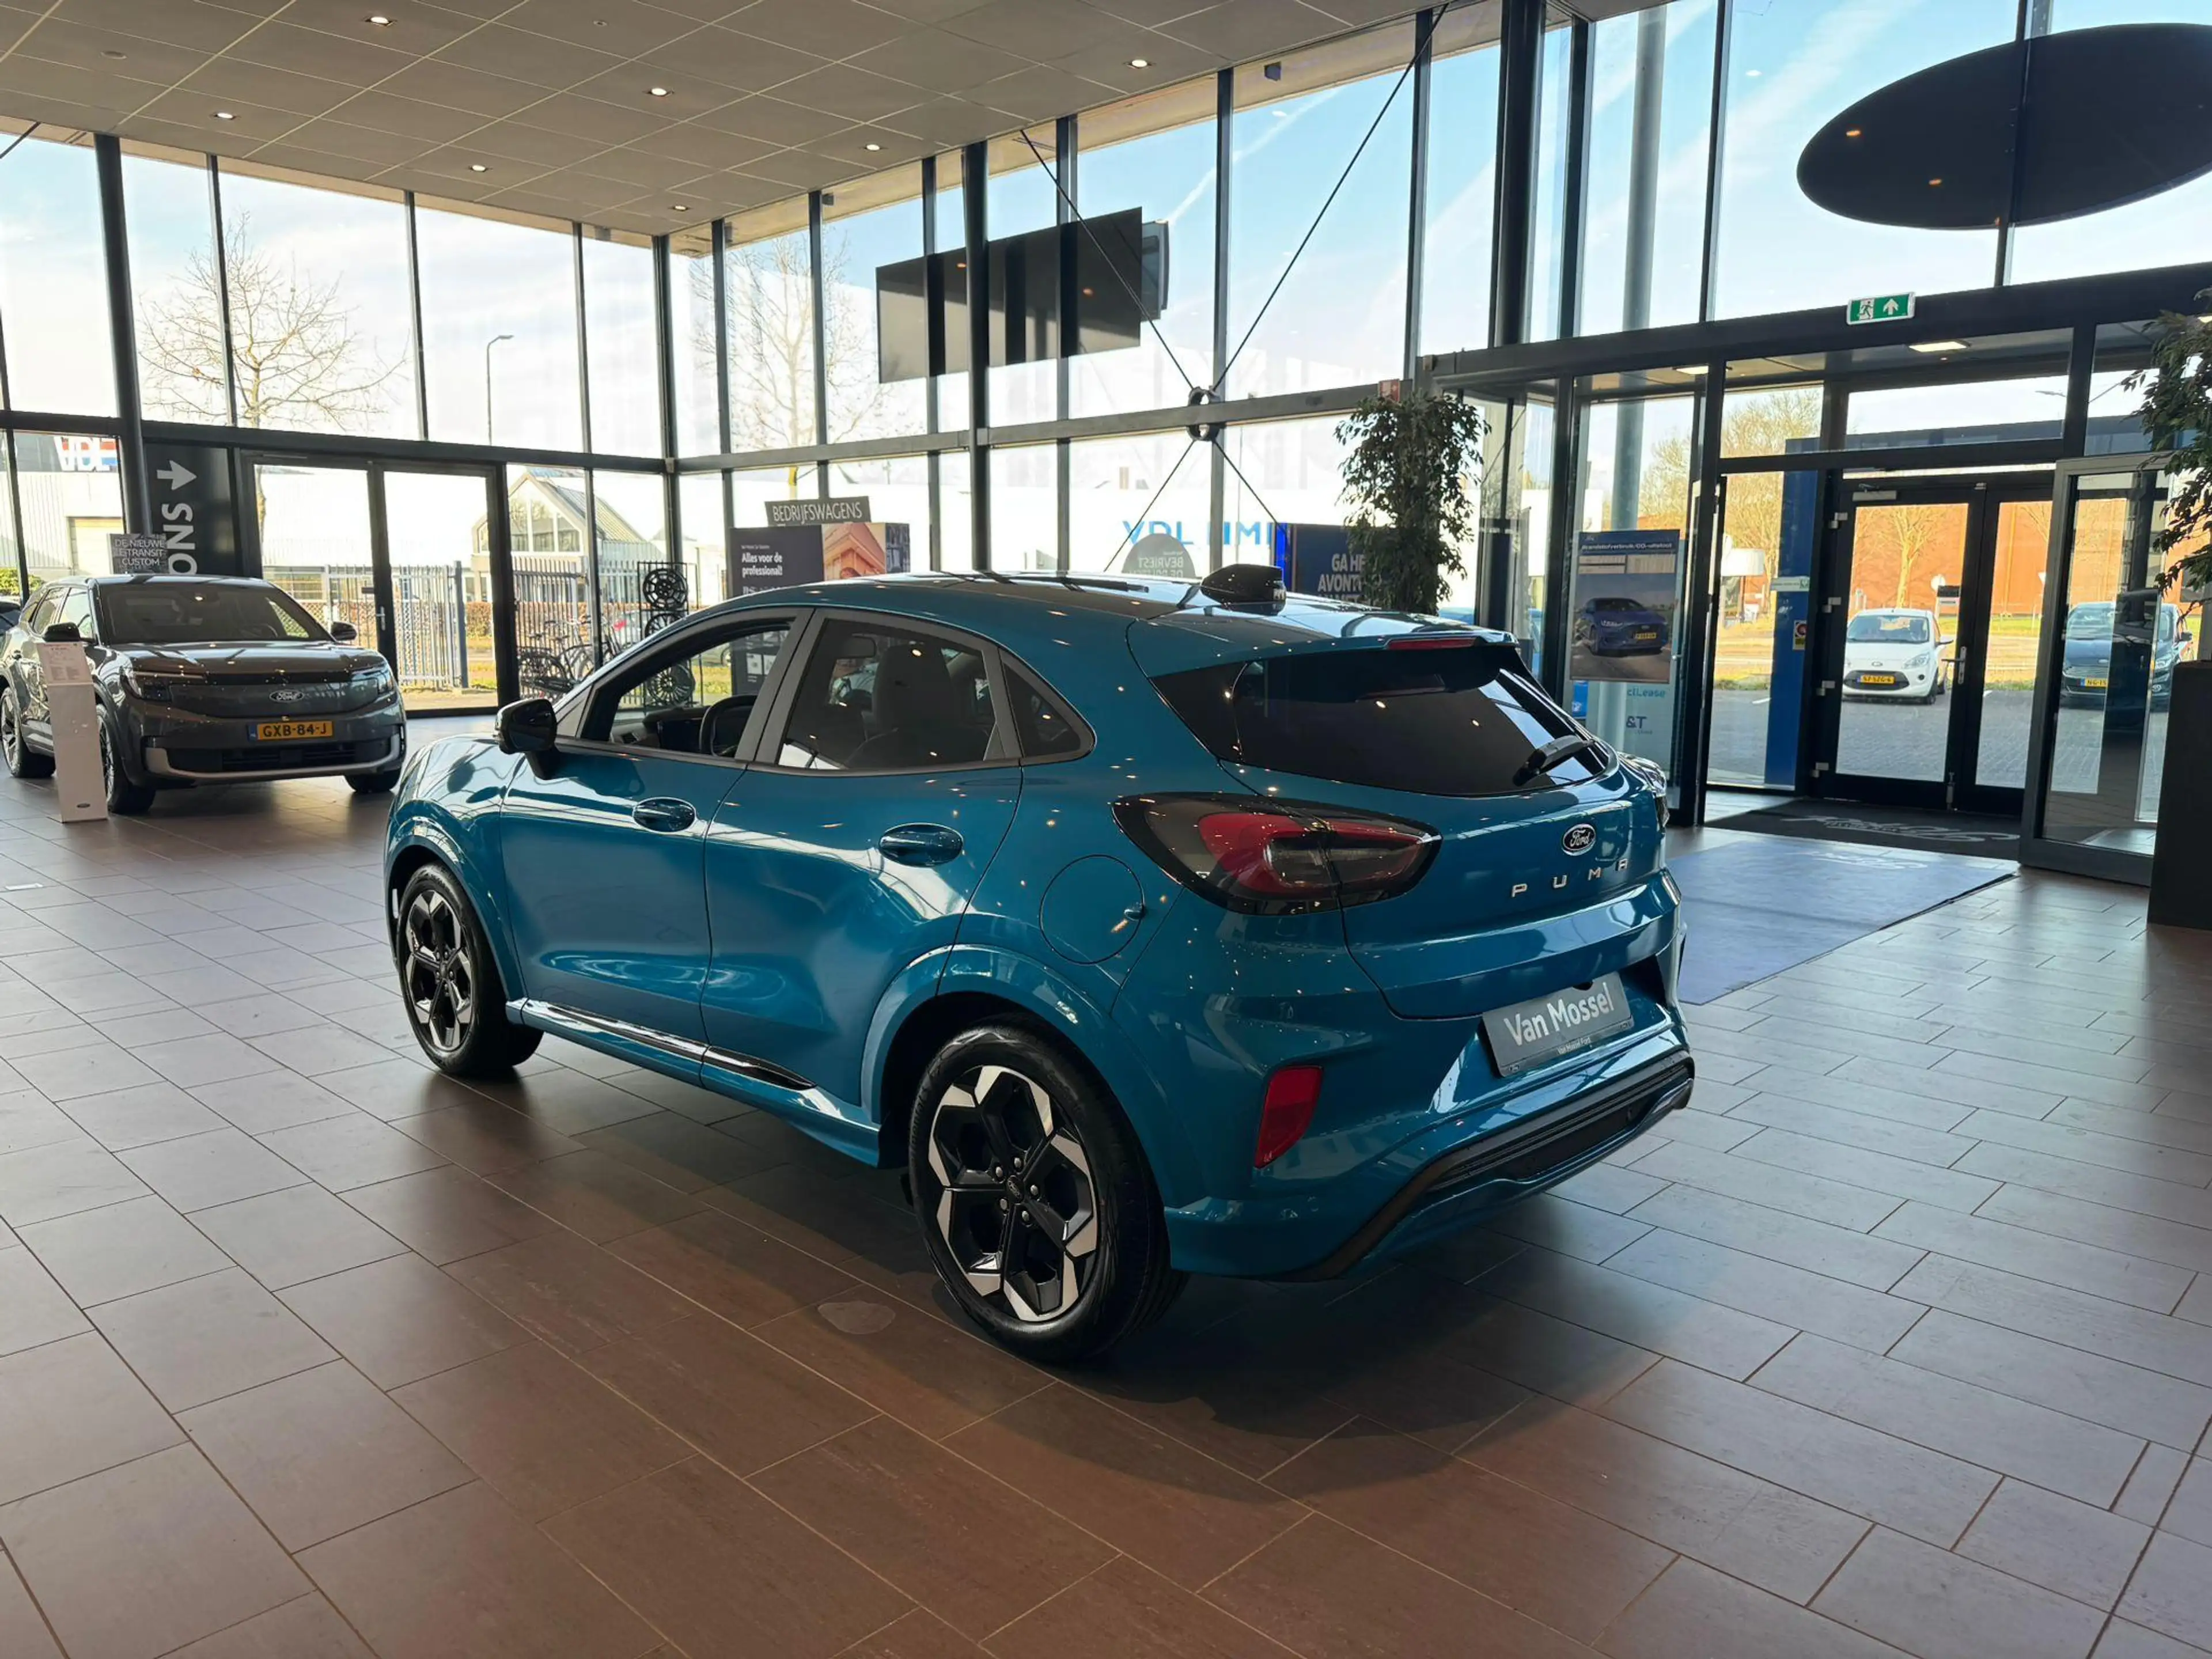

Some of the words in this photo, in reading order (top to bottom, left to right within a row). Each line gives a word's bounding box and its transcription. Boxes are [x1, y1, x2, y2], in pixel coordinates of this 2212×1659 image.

[772, 502, 863, 525] BEDRIJFSWAGENS
[122, 558, 160, 566] CUSTOM
[742, 552, 757, 563] Alles
[758, 555, 773, 563] voor
[774, 552, 783, 563] de
[1331, 553, 1348, 571] GA
[263, 723, 326, 737] GXB-84-J
[1511, 858, 1628, 897] PUMA
[1503, 1013, 1550, 1046] Van
[1547, 982, 1614, 1032] Mossel
